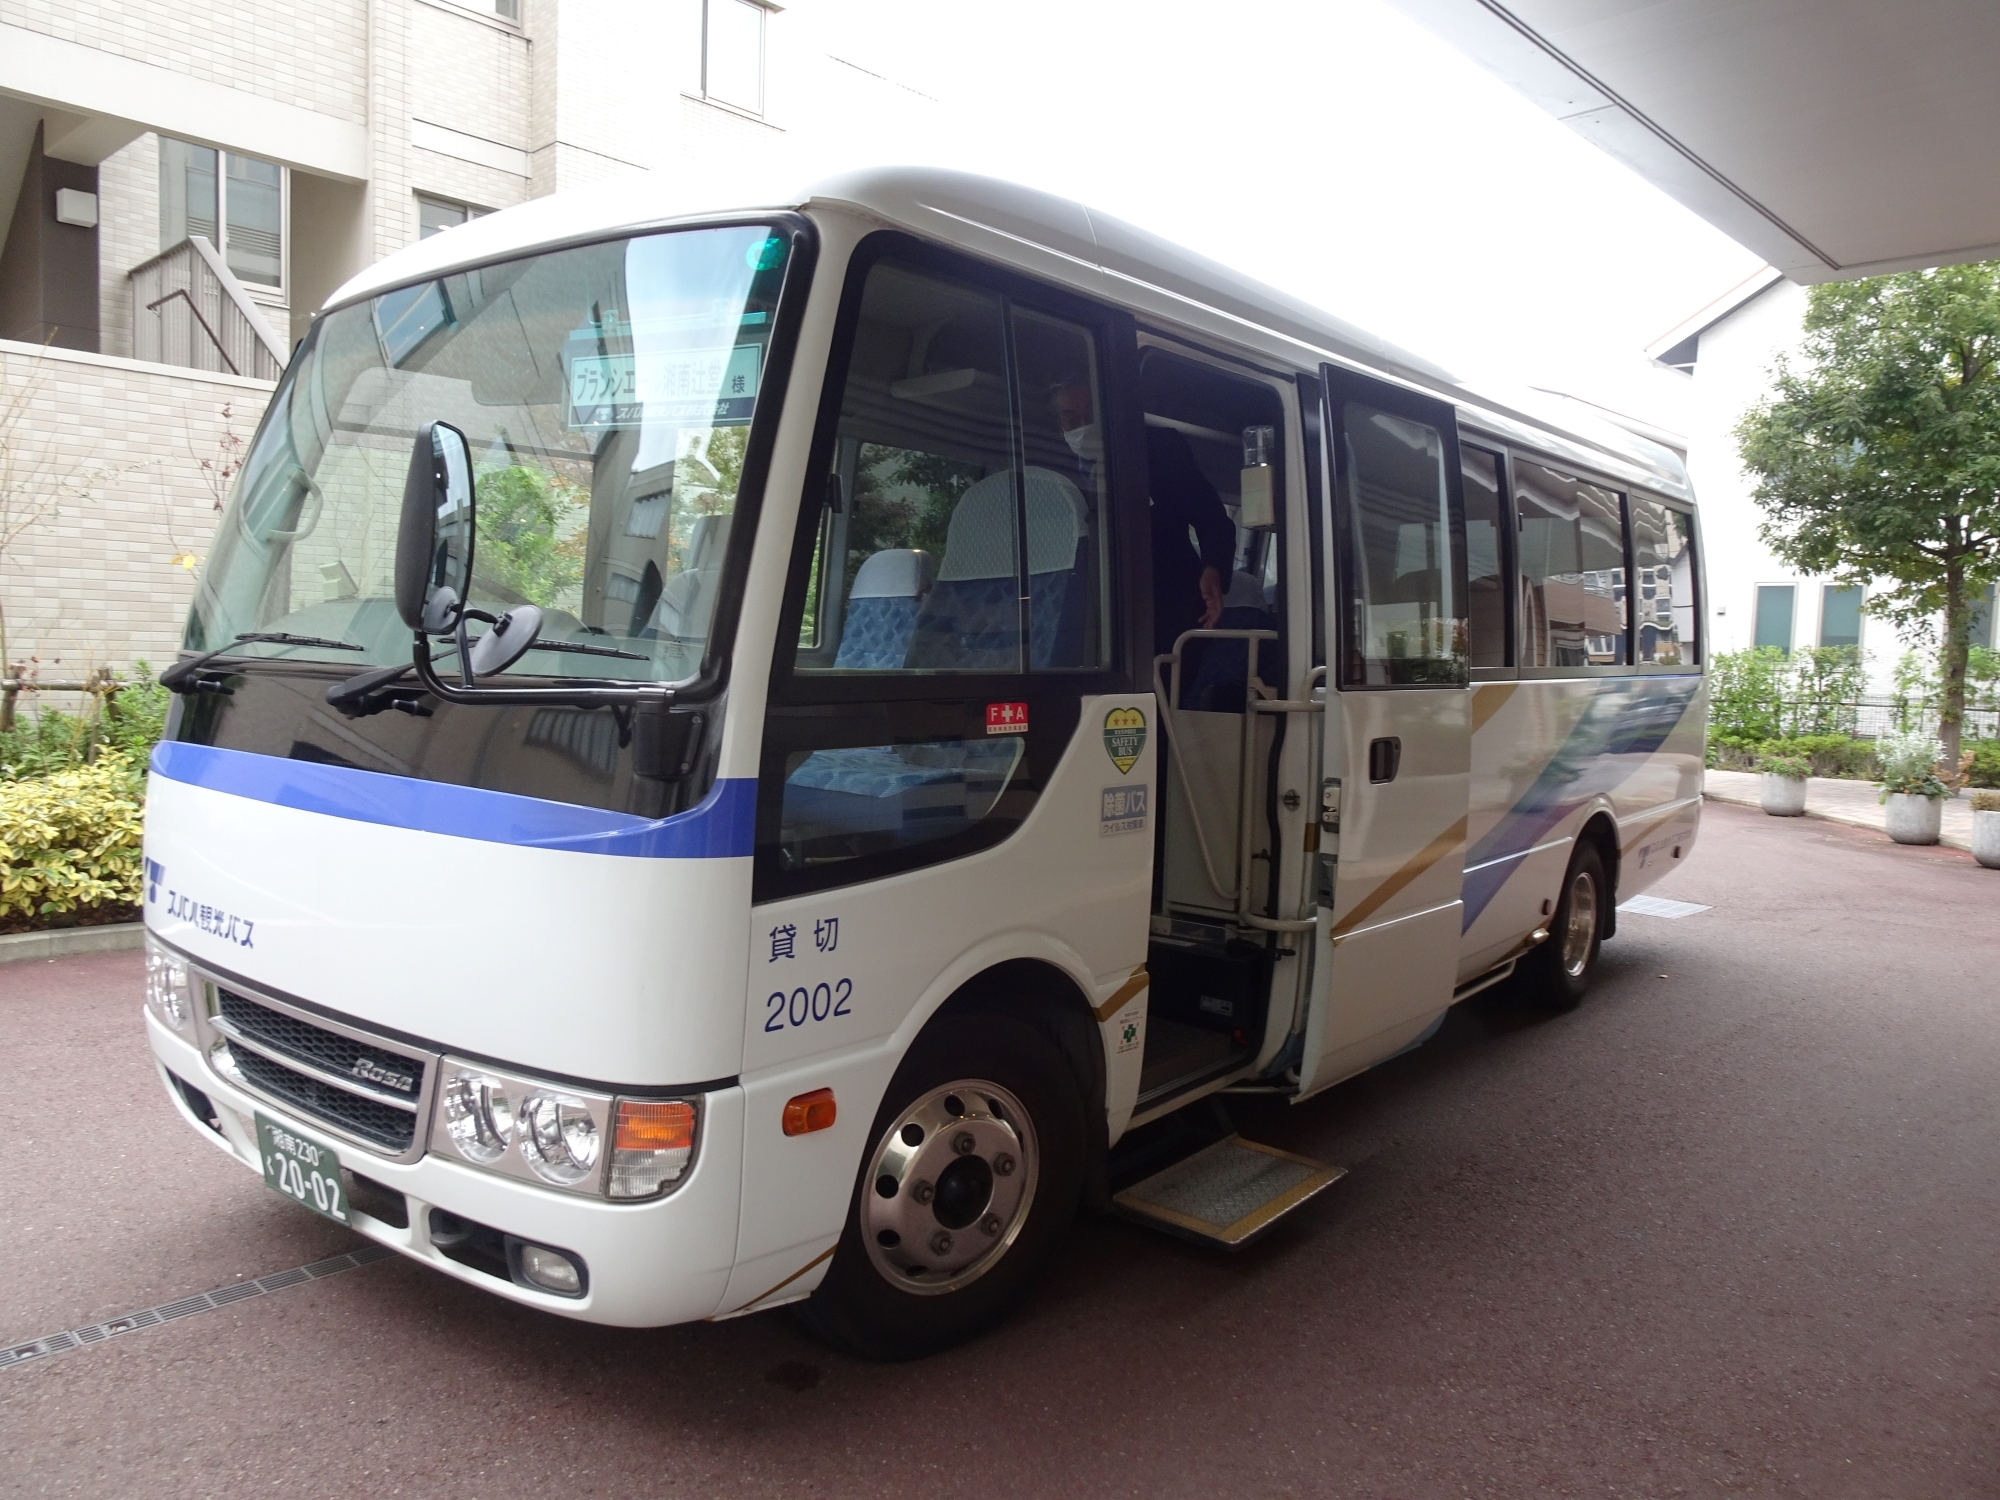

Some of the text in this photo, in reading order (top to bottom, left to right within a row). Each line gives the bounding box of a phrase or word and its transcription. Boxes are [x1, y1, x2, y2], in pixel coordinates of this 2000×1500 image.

[732, 375, 746, 393] 様
[1112, 737, 1139, 747] SAFETY
[1118, 746, 1133, 756] BUS
[1103, 790, 1146, 818] 除菌バス
[768, 917, 839, 963] 貸切
[764, 977, 853, 1032] 2002
[274, 1152, 347, 1220] 20-02
